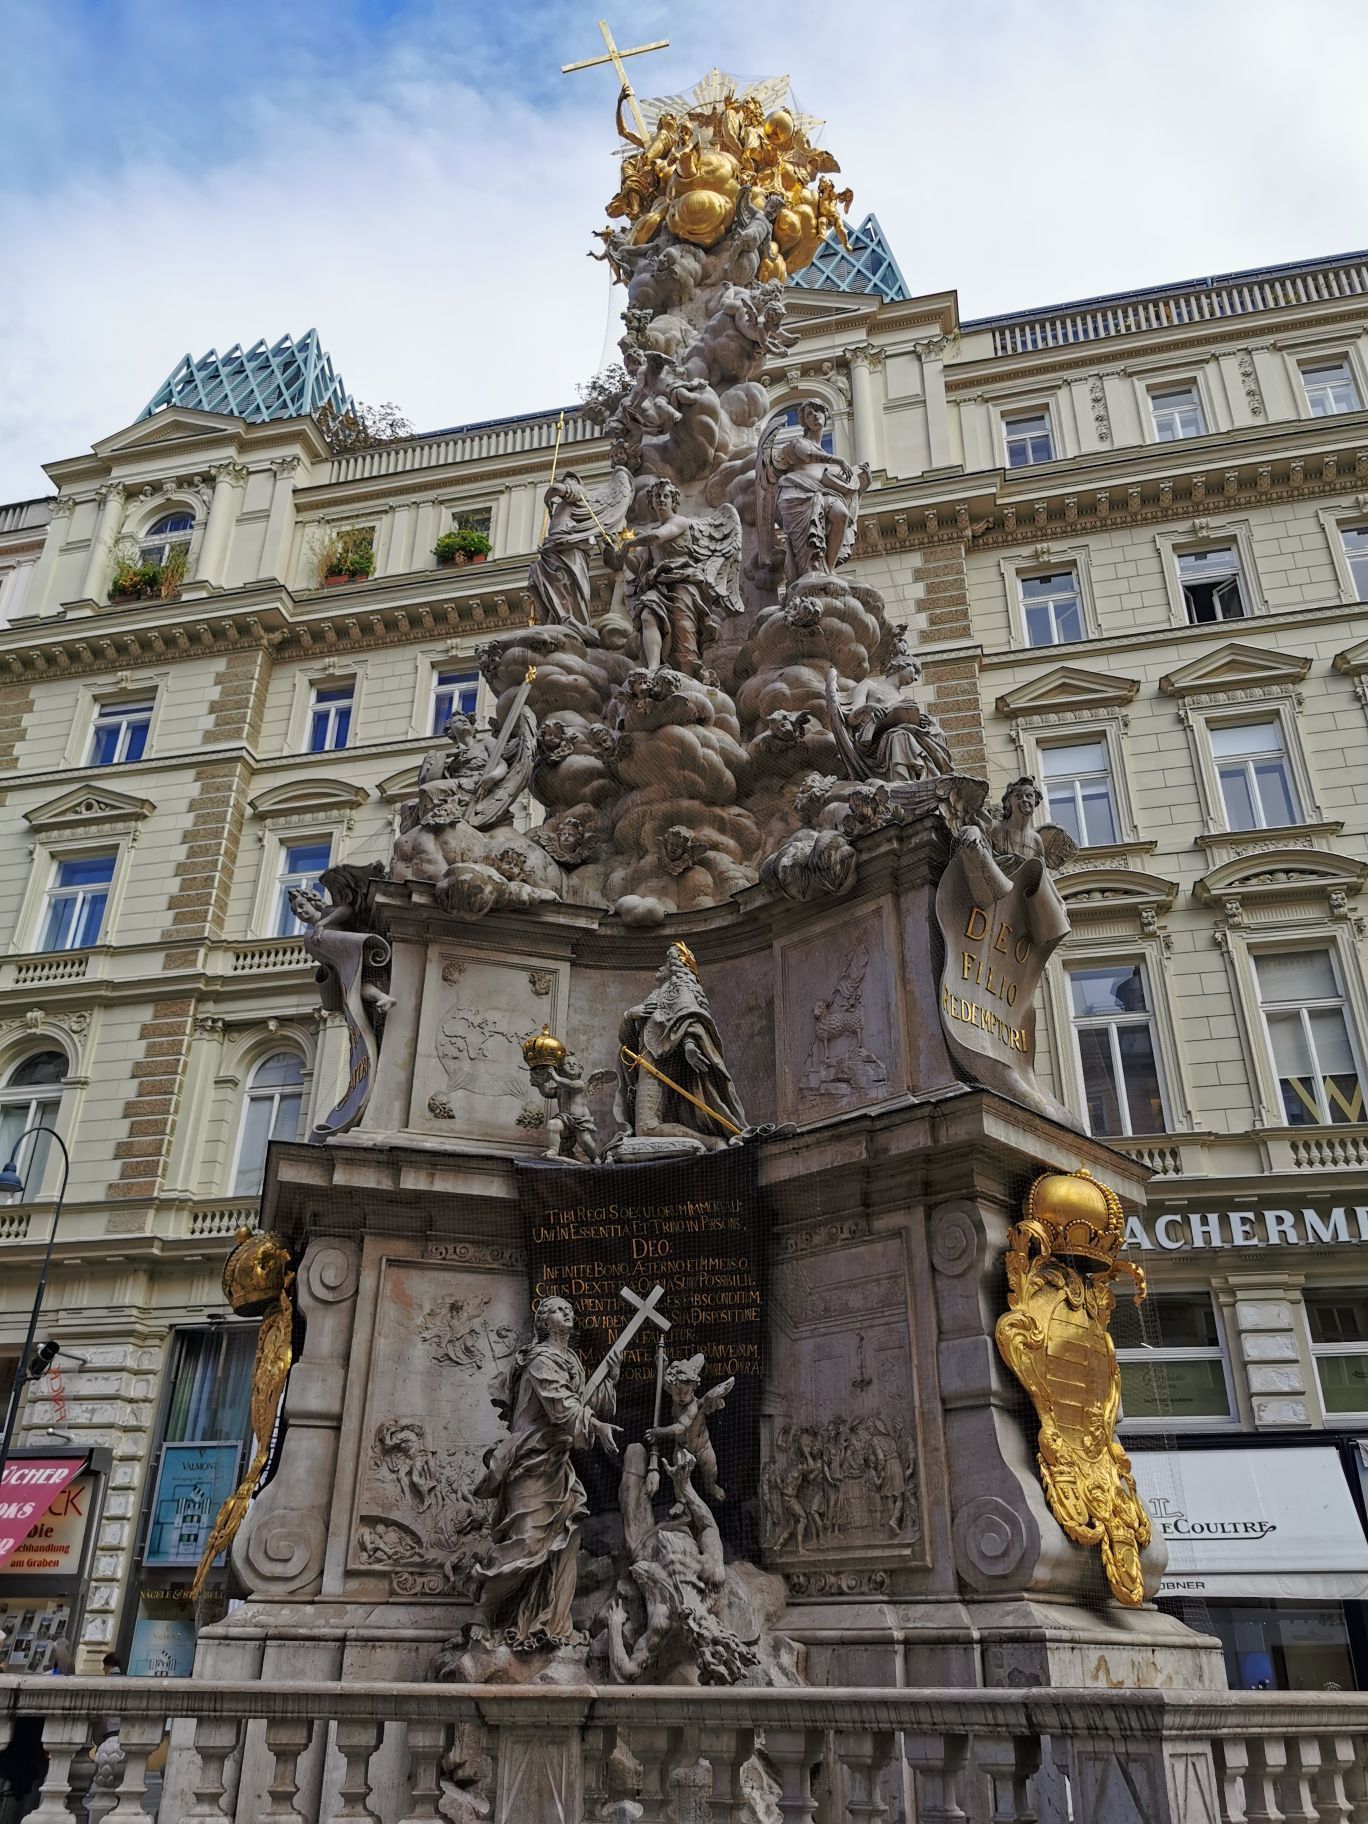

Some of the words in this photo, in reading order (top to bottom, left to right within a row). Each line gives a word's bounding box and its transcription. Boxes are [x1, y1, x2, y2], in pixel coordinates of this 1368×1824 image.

[964, 906, 1030, 965] DEO
[961, 952, 1018, 1007] FILIO
[943, 984, 1028, 1053] REDEMPTORI
[577, 1206, 606, 1221] REGI
[1, 1466, 69, 1485] ÜCHER
[26, 1558, 60, 1568] Graben
